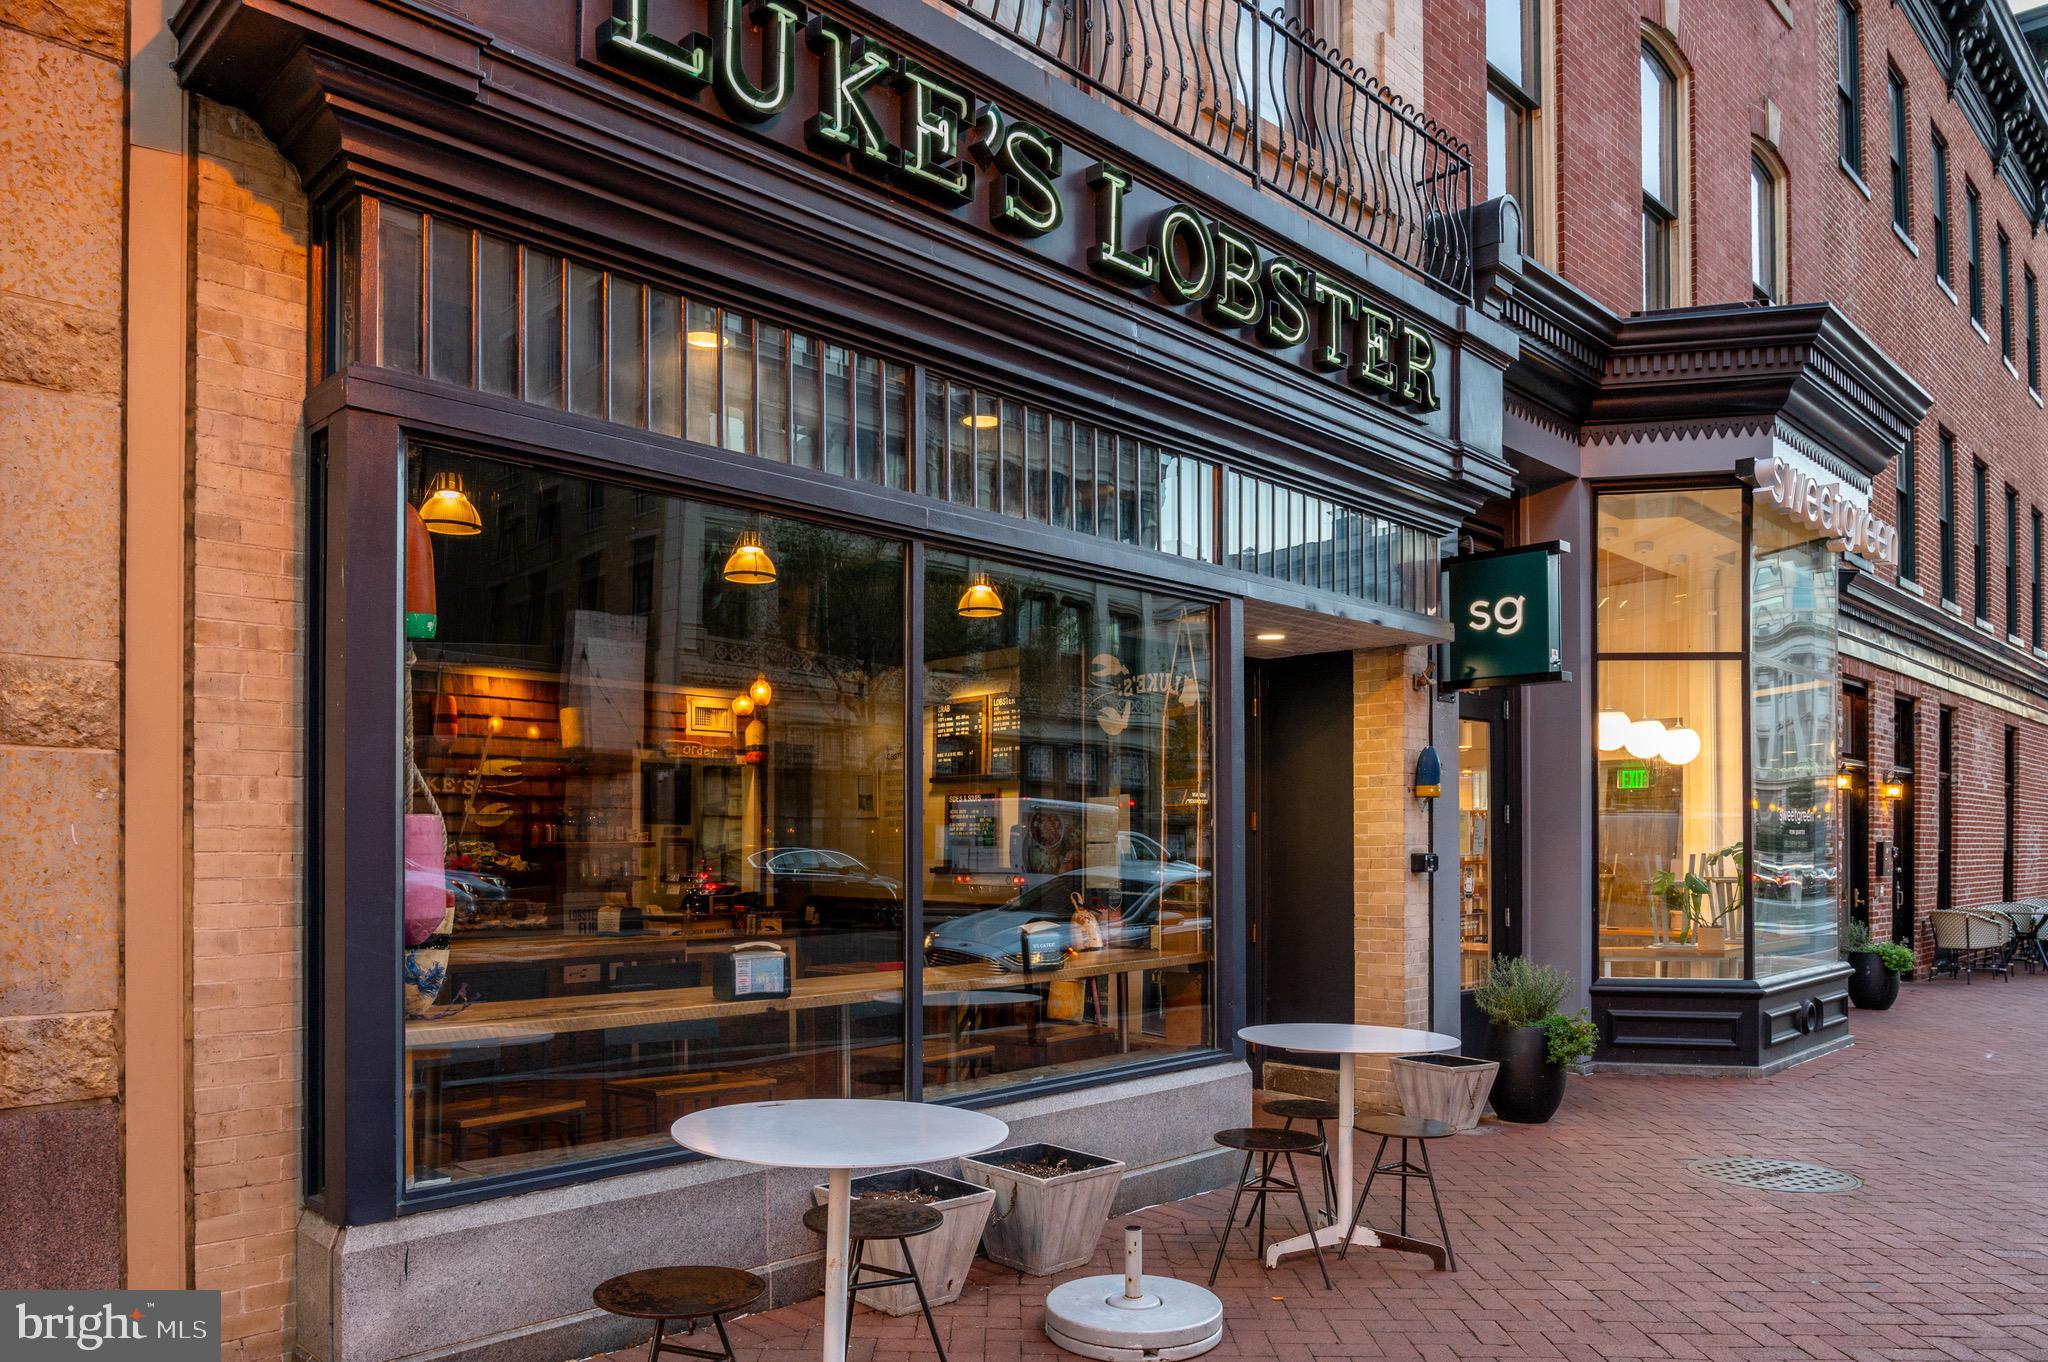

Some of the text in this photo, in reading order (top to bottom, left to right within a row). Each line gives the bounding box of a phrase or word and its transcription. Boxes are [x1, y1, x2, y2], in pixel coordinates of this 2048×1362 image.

[595, 0, 1441, 414] LUKE'S LOBSTER
[1753, 456, 1899, 566] sweetgreen
[1469, 595, 1526, 636] sg
[682, 745, 718, 758] order
[1622, 770, 1646, 788] EXIT
